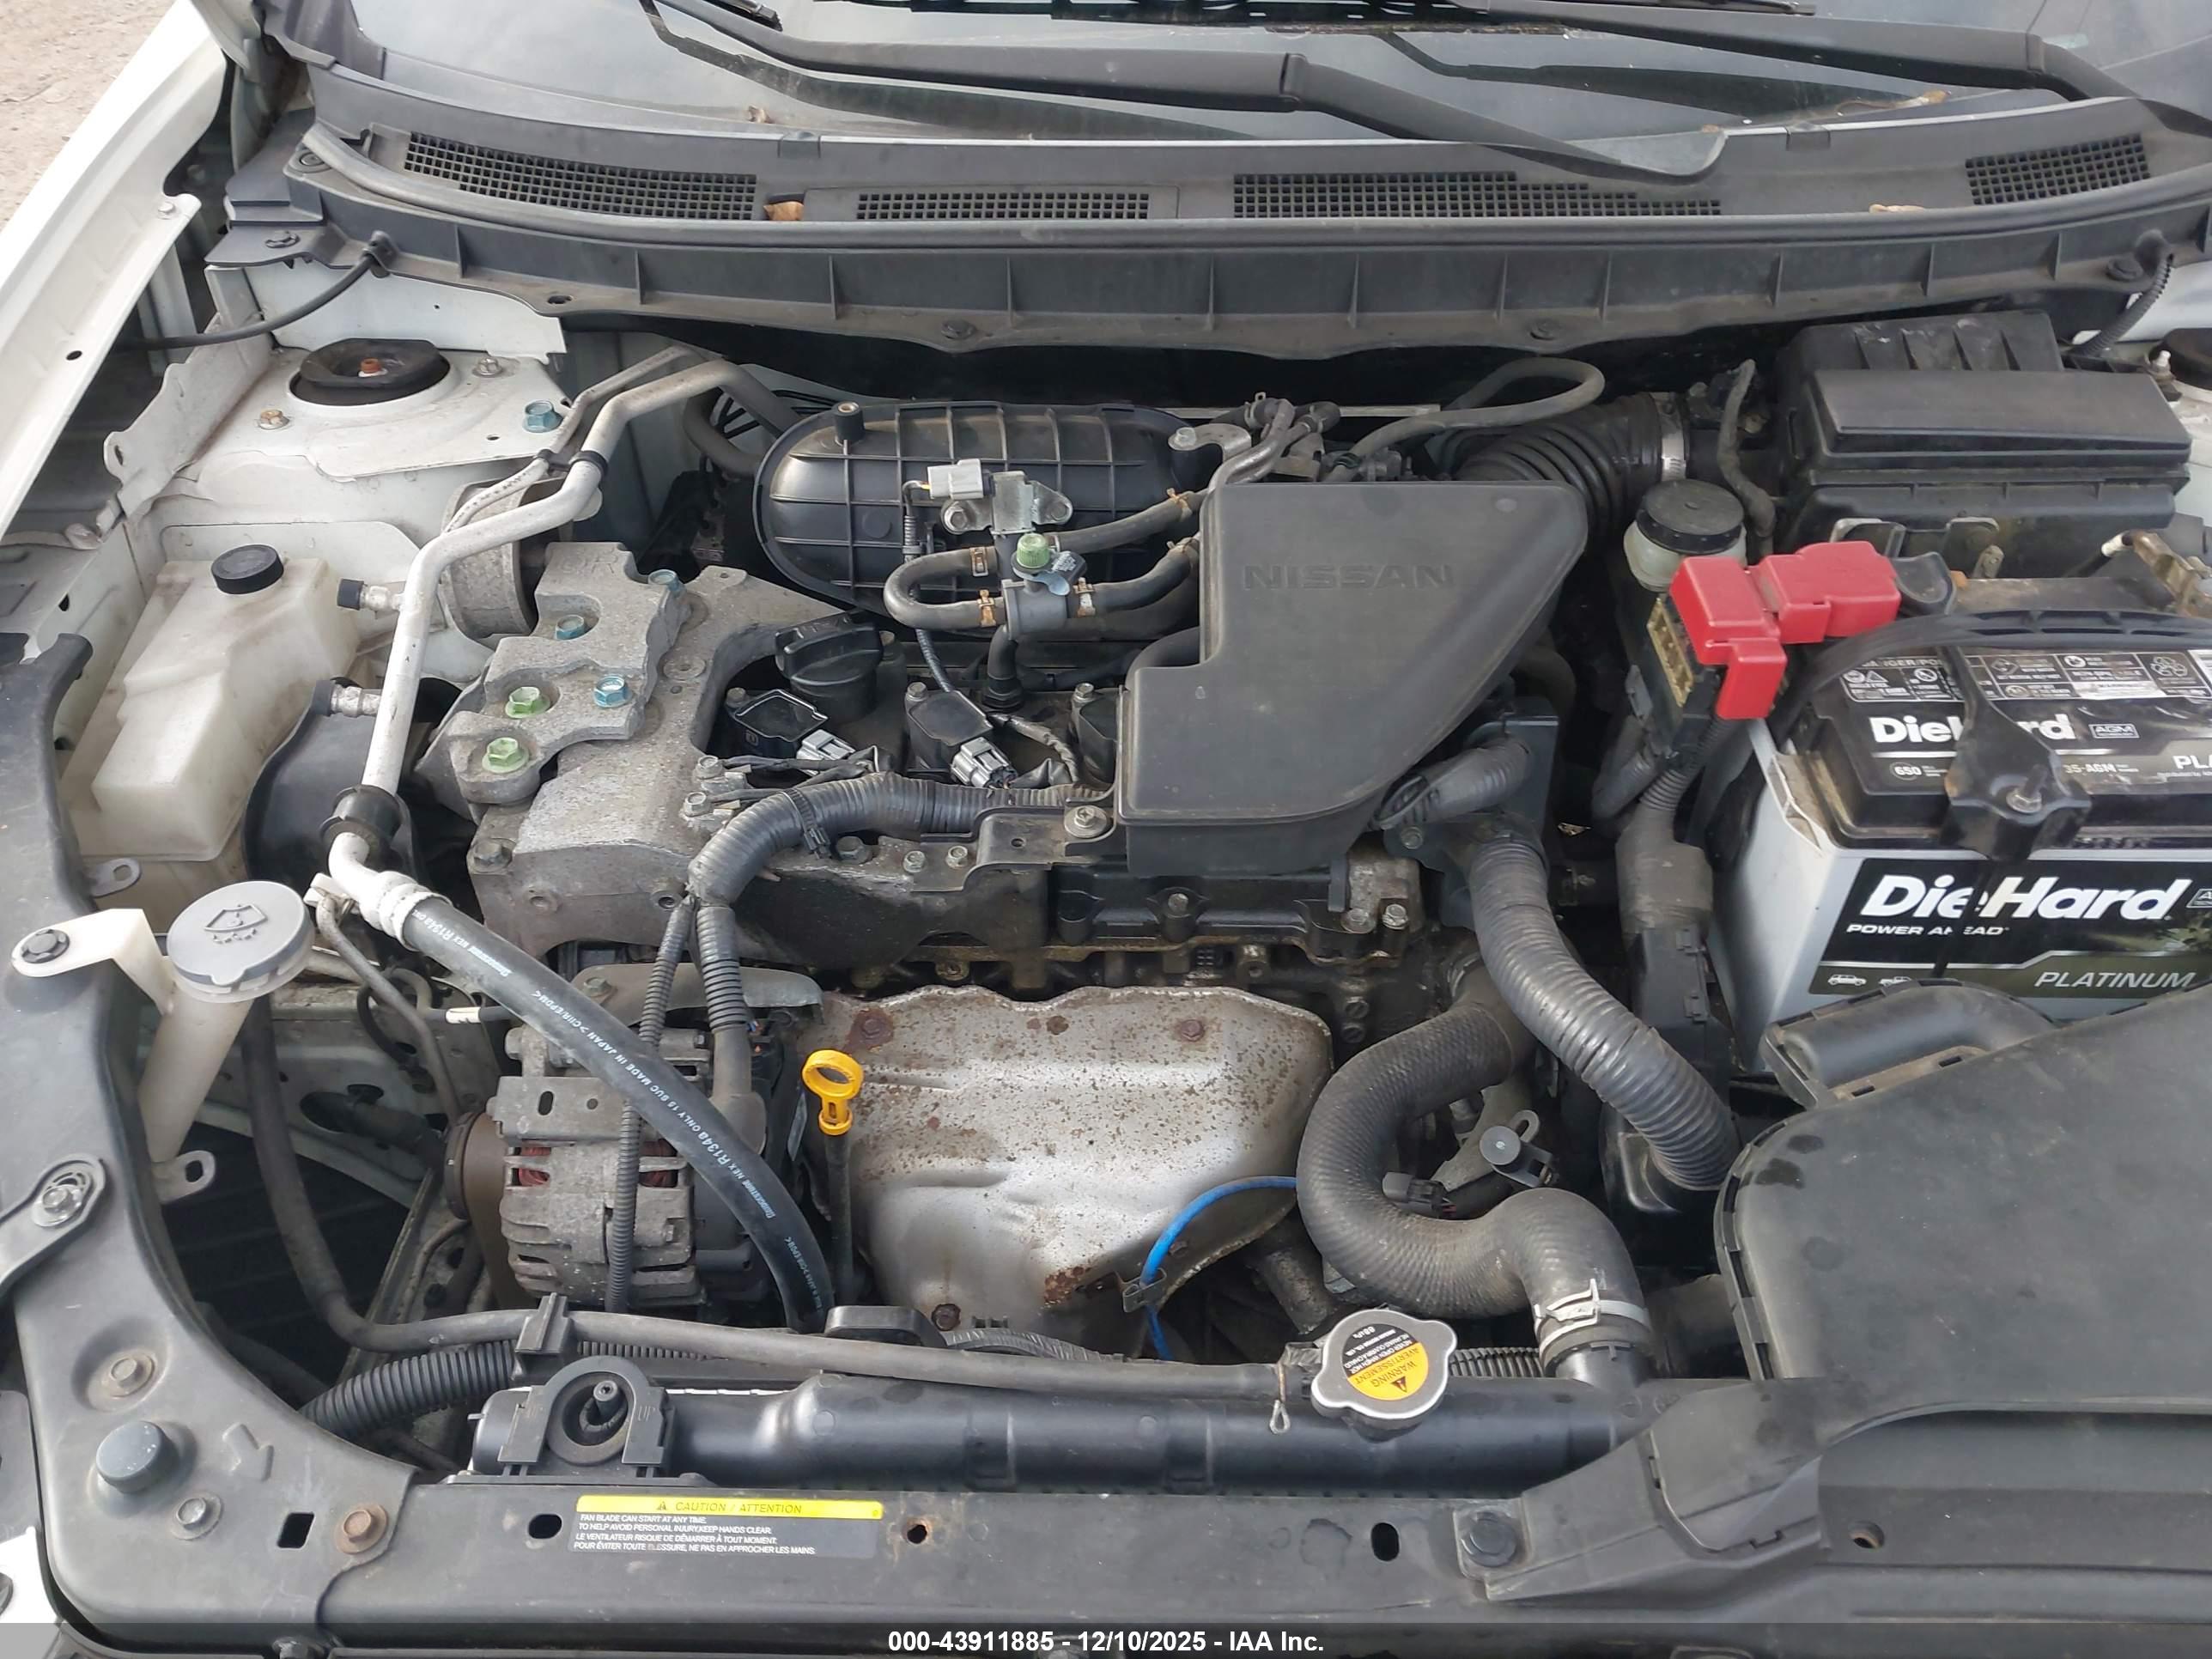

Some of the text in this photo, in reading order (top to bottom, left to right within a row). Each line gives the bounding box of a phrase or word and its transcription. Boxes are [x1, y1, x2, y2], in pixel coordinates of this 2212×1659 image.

[1243, 564, 1457, 590] NISSAN
[1894, 766, 1922, 776] 650
[1860, 874, 2192, 920] DieHard
[1846, 925, 1923, 935] POWER
[2034, 972, 2196, 988] PLATINUM
[586, 1031, 617, 1056] JAPAN
[615, 1054, 628, 1066] IN
[626, 1062, 651, 1086] MADE
[677, 1109, 702, 1132] ONLY
[697, 1131, 731, 1165] R134a
[1354, 1347, 1419, 1384] AVERTISSEMENT
[1370, 1360, 1416, 1388] WARNING
[676, 1502, 726, 1511] CAUTION
[740, 1504, 801, 1514] ATTENTION
